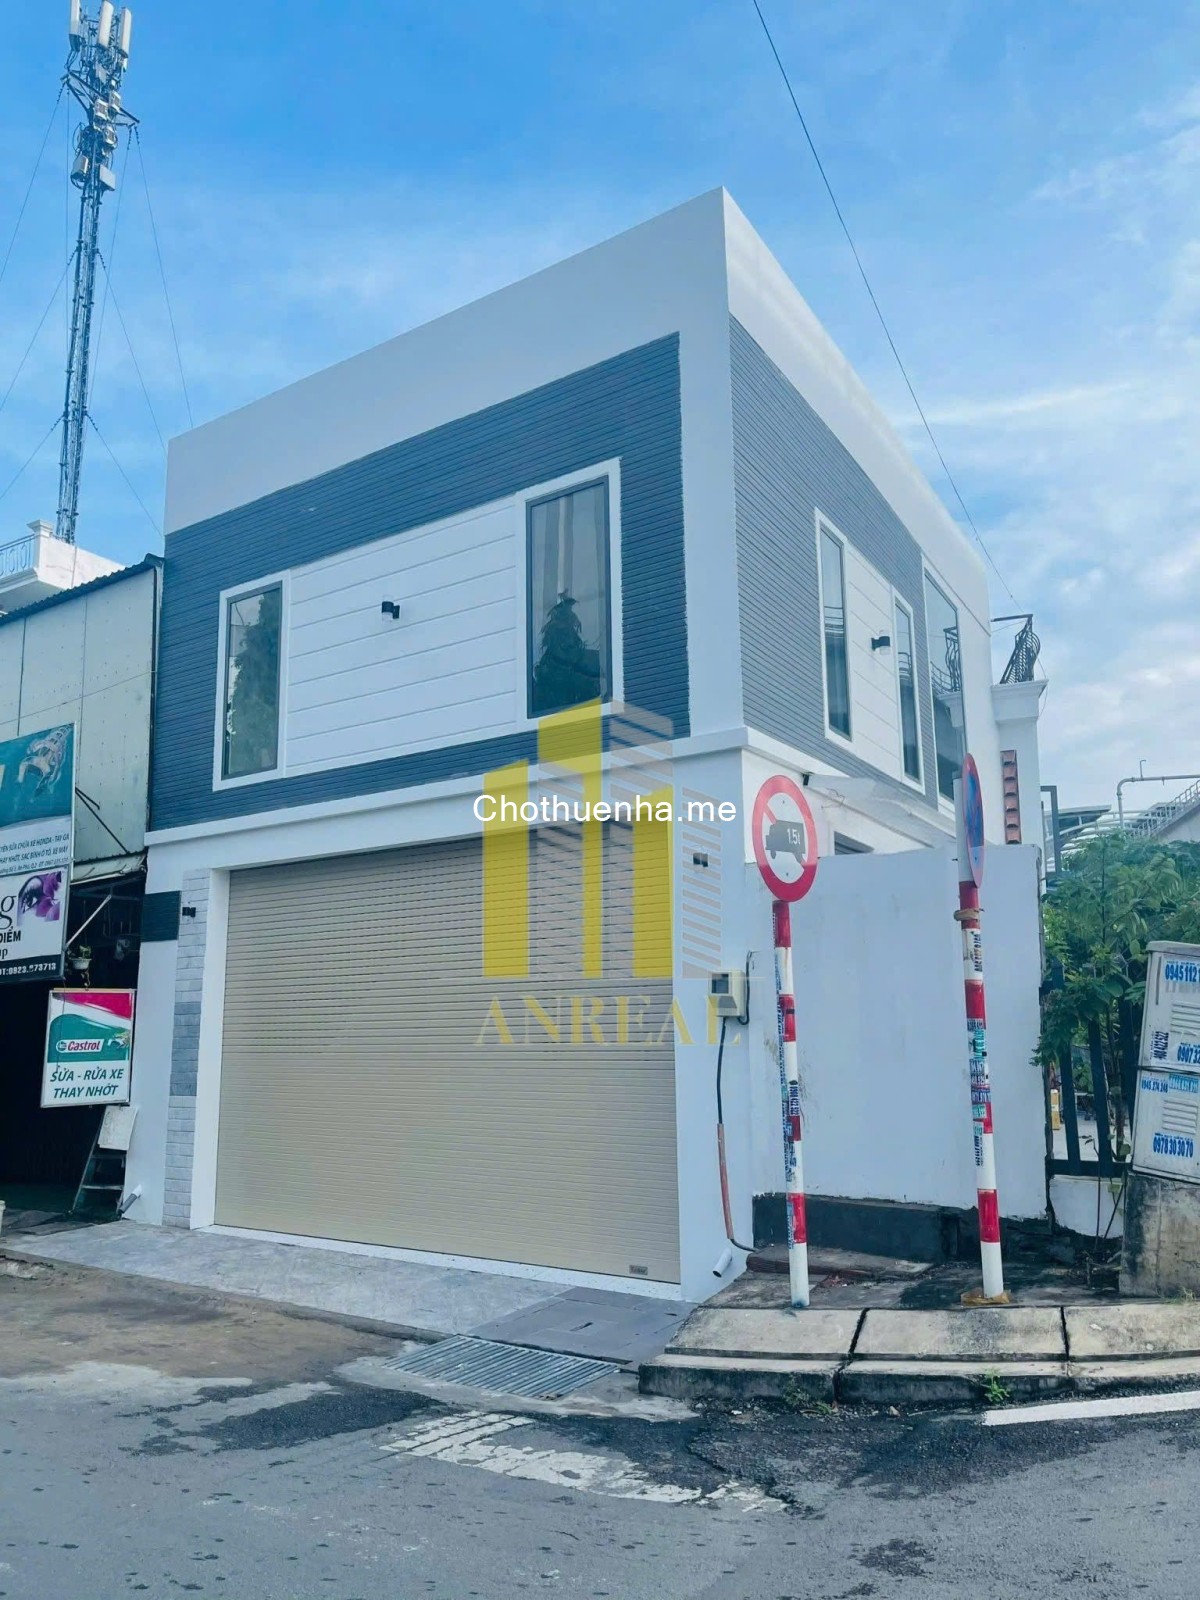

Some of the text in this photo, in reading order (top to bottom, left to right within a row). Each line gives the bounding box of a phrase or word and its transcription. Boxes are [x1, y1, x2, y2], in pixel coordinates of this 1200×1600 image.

[67, 1041, 100, 1051] Castrol
[50, 1067, 74, 1082] SỬA
[83, 1066, 107, 1081] RỬA
[109, 1068, 124, 1080] XE
[53, 1086, 85, 1099] THAY
